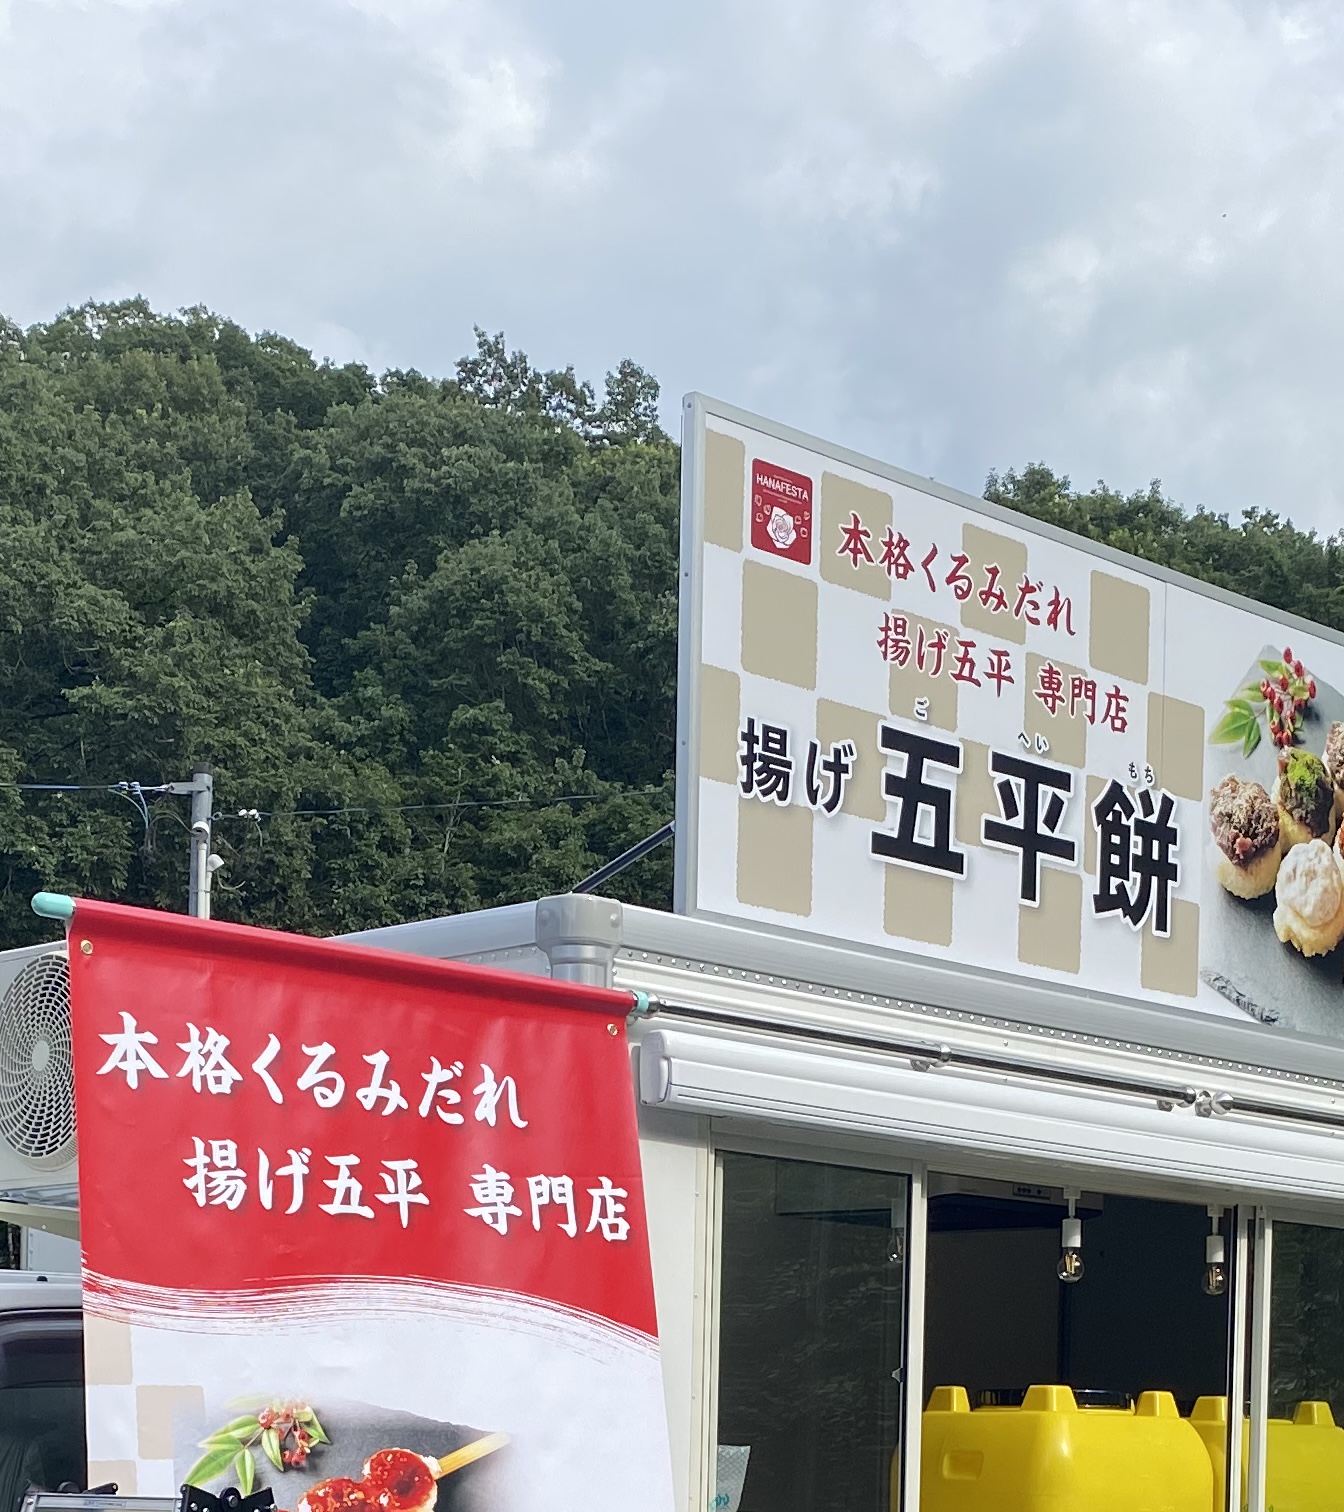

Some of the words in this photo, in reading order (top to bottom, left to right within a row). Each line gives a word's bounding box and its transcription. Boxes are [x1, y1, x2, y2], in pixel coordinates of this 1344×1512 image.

[756, 473, 809, 501] HANAFESTA
[836, 510, 1077, 636] 本格くるみだれ
[877, 612, 1015, 698] 揚げ五平
[1033, 663, 1129, 733] 専門店
[1128, 761, 1154, 784] もち
[96, 1011, 529, 1129] 本格くるみだれ
[182, 1137, 430, 1228] 揚げ五平
[462, 1164, 631, 1242] 専門店
